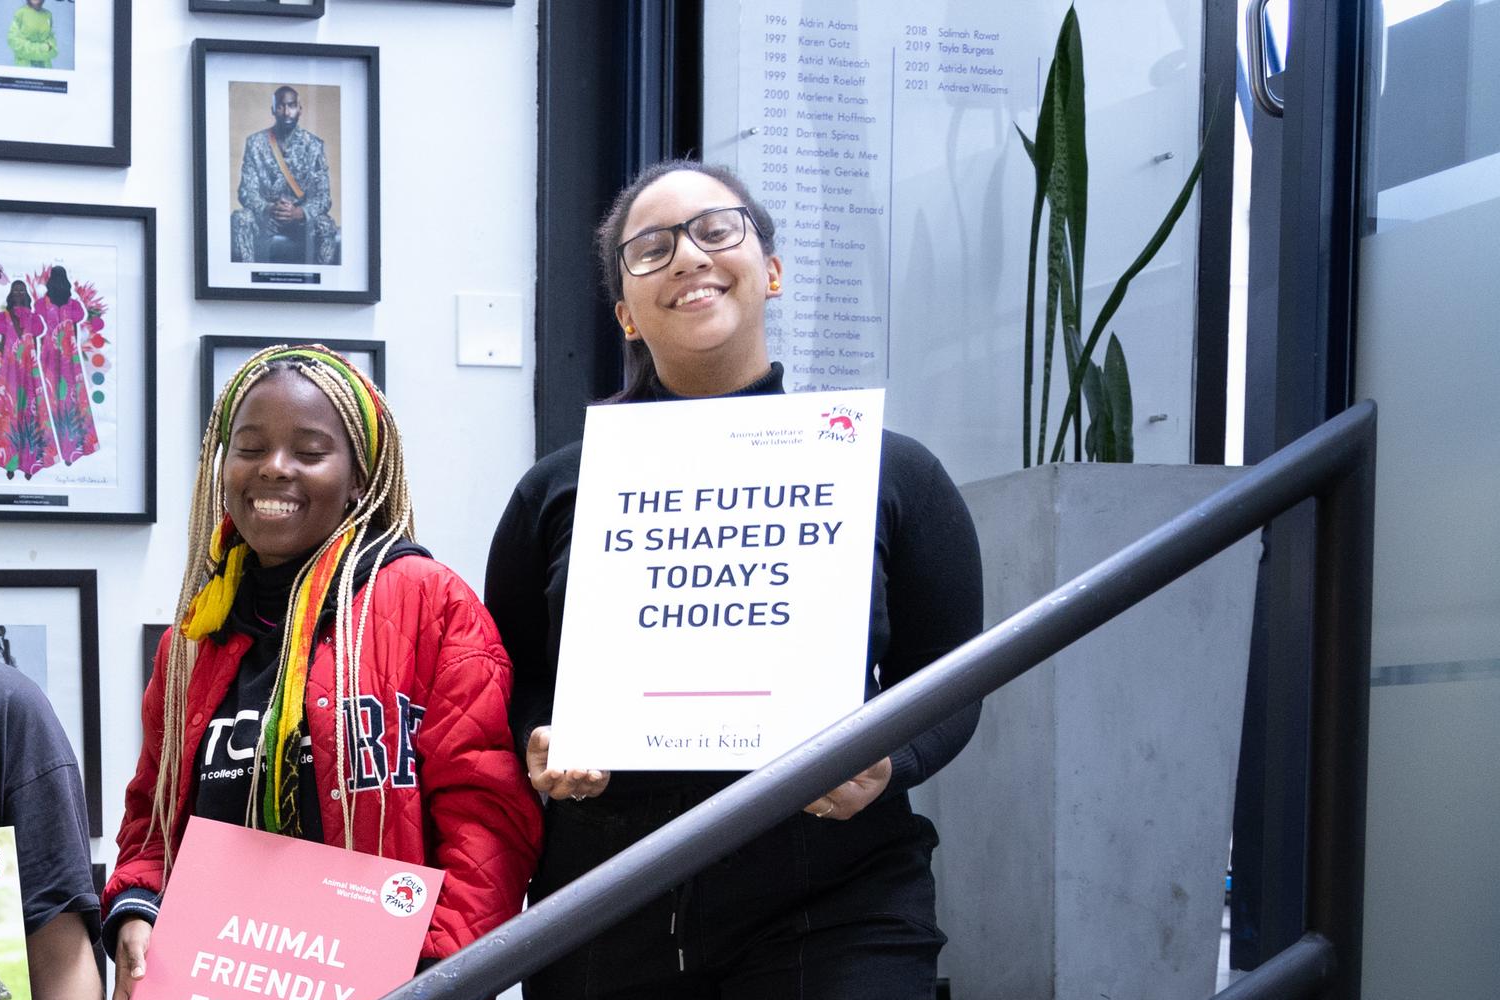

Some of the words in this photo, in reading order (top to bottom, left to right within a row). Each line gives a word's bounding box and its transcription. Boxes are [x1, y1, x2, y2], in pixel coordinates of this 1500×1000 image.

[765, 15, 787, 26] 1996
[799, 18, 824, 28] Aldrin
[828, 20, 858, 31] Adams
[906, 25, 927, 36] 2018
[974, 31, 999, 40] Rawat
[765, 33, 787, 43] 1997
[798, 36, 825, 46] Karen
[906, 41, 931, 51] 2019
[963, 44, 994, 56] Burgess
[765, 52, 787, 63] 1998
[798, 56, 823, 66] Astrid
[906, 61, 929, 71] 2020
[765, 71, 786, 80] 1999
[797, 73, 829, 84] Belinda
[906, 80, 928, 90] 2021
[938, 82, 969, 93] Andrea
[972, 83, 1008, 94] Williams
[764, 89, 789, 100] 2000
[797, 92, 834, 102] Marlene
[838, 94, 868, 104] Roman
[764, 108, 786, 118] 2001
[764, 126, 788, 137] 2002
[796, 128, 827, 139] Darren
[763, 145, 788, 154] 2004
[762, 163, 788, 173] 2005
[762, 181, 788, 191] 2006
[796, 183, 817, 193] Theo
[849, 204, 884, 215] Barnard
[795, 221, 820, 229] Astrid
[825, 221, 840, 232] Ray
[826, 275, 862, 286] Dawson
[618, 490, 683, 514] THE
[694, 483, 835, 511] FUTURE
[604, 529, 634, 552] IS
[644, 524, 786, 551] SHAPED
[799, 521, 843, 546] BY
[647, 562, 790, 589] TODAY'S
[638, 601, 791, 628] CHOICES
[647, 735, 692, 747] Wear
[699, 734, 709, 747] it
[719, 734, 760, 747] Kind
[208, 768, 243, 779] college
[322, 878, 348, 889] Animal
[400, 876, 423, 895] FOUR
[386, 895, 414, 913] PAWS
[217, 915, 345, 968] ANIMAL
